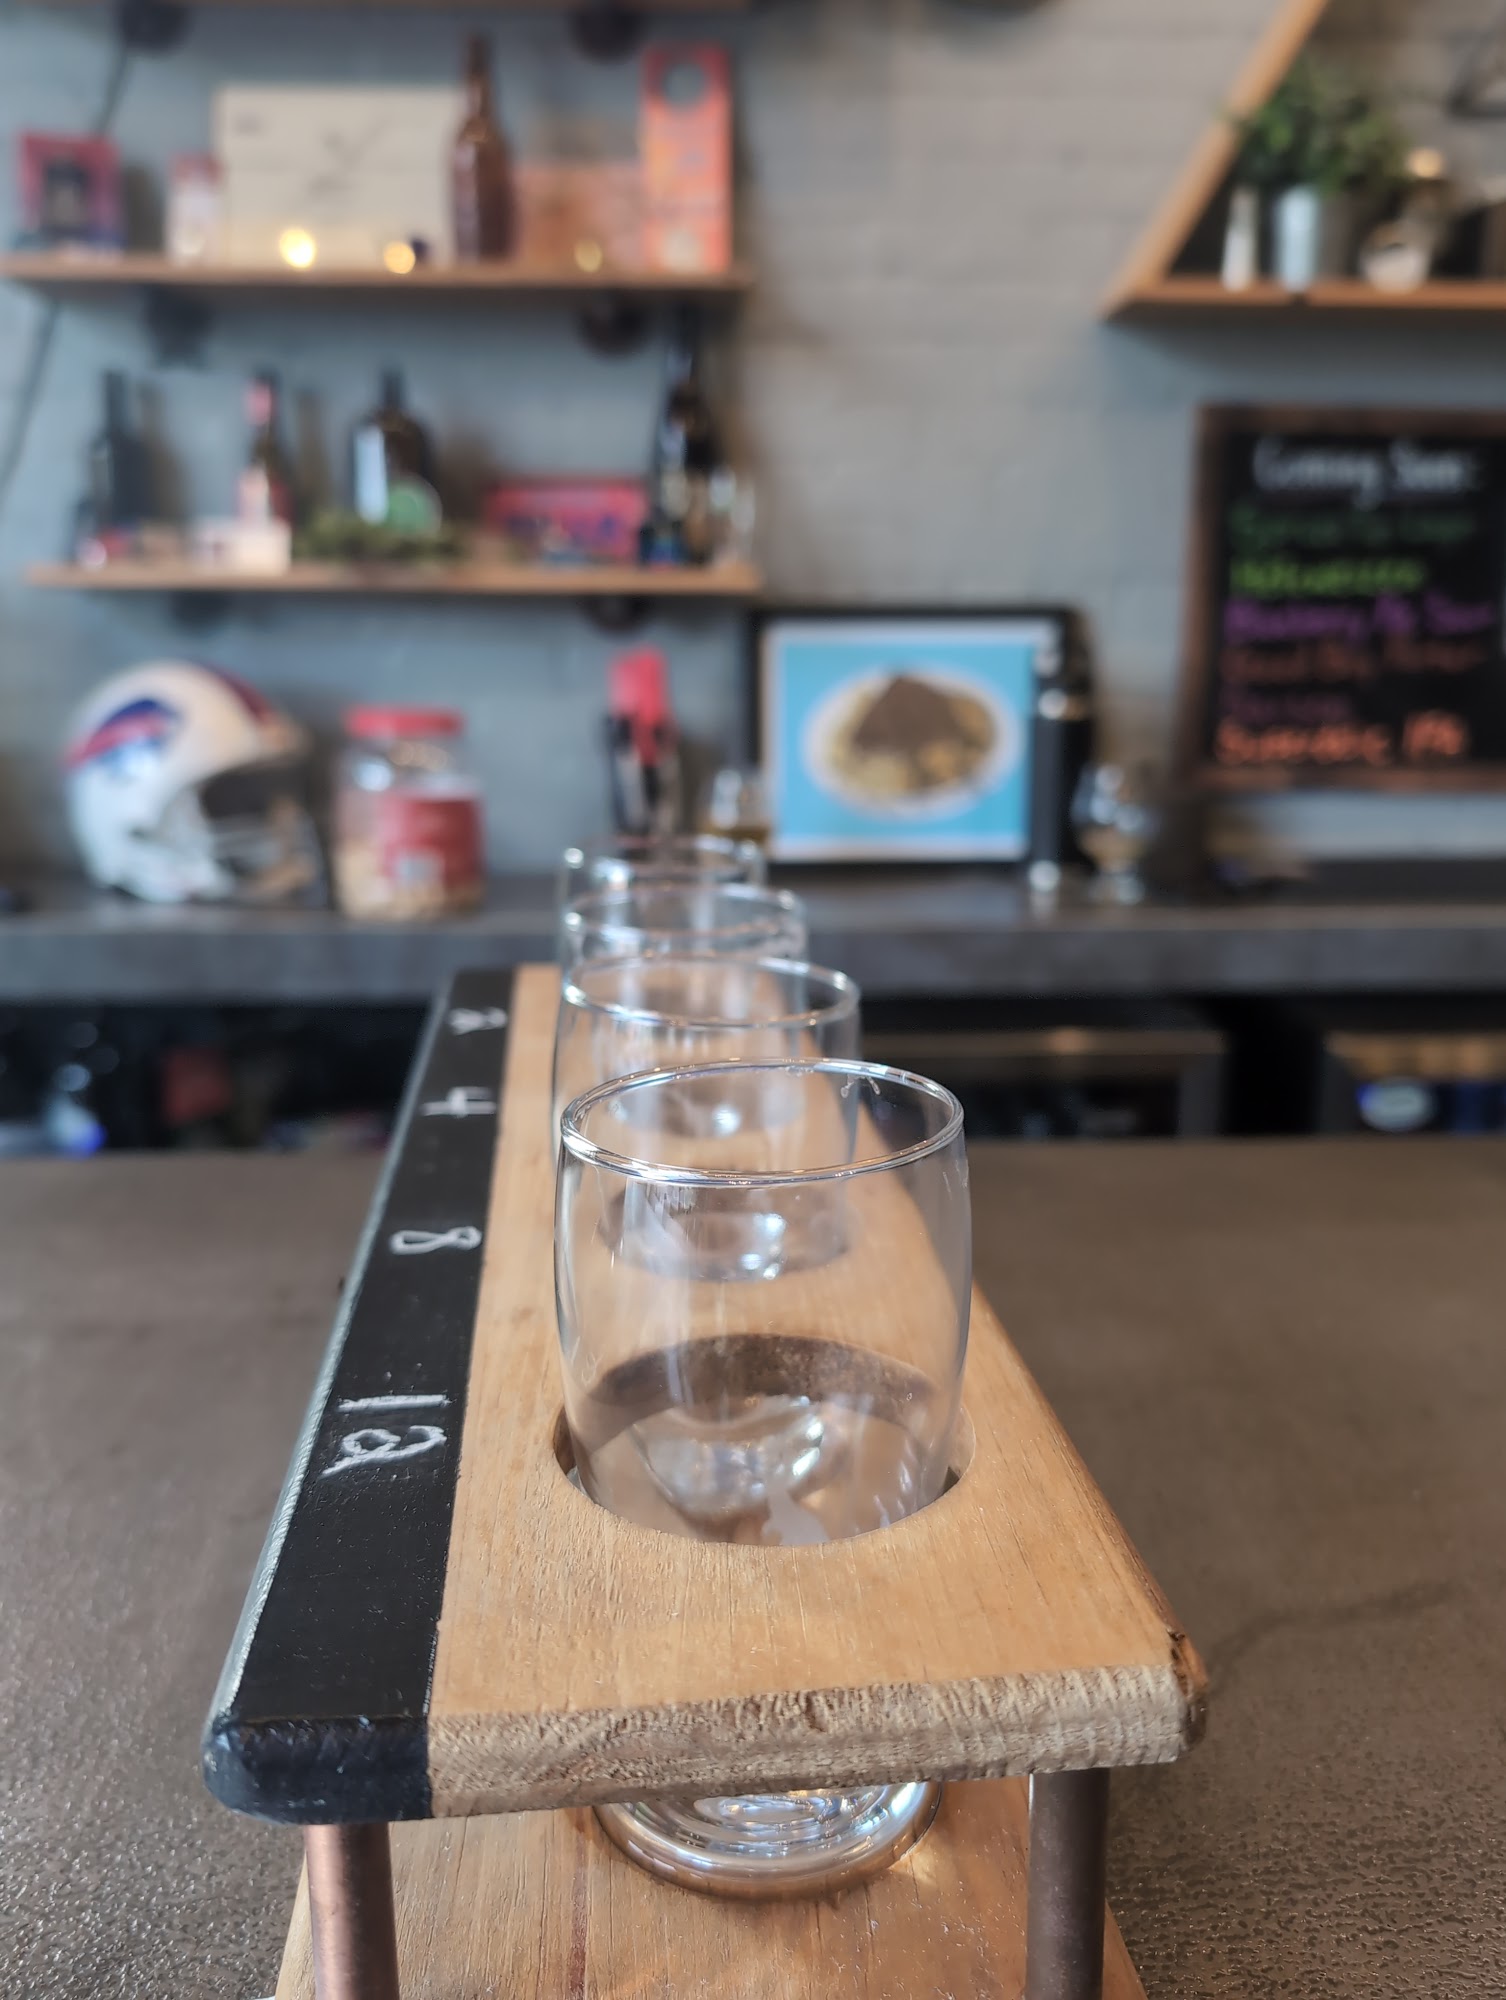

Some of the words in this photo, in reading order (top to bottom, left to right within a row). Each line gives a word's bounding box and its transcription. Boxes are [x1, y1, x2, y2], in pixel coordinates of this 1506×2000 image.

[421, 1086, 497, 1117] 4
[390, 1225, 483, 1255] 8
[320, 1393, 452, 1478] 12
